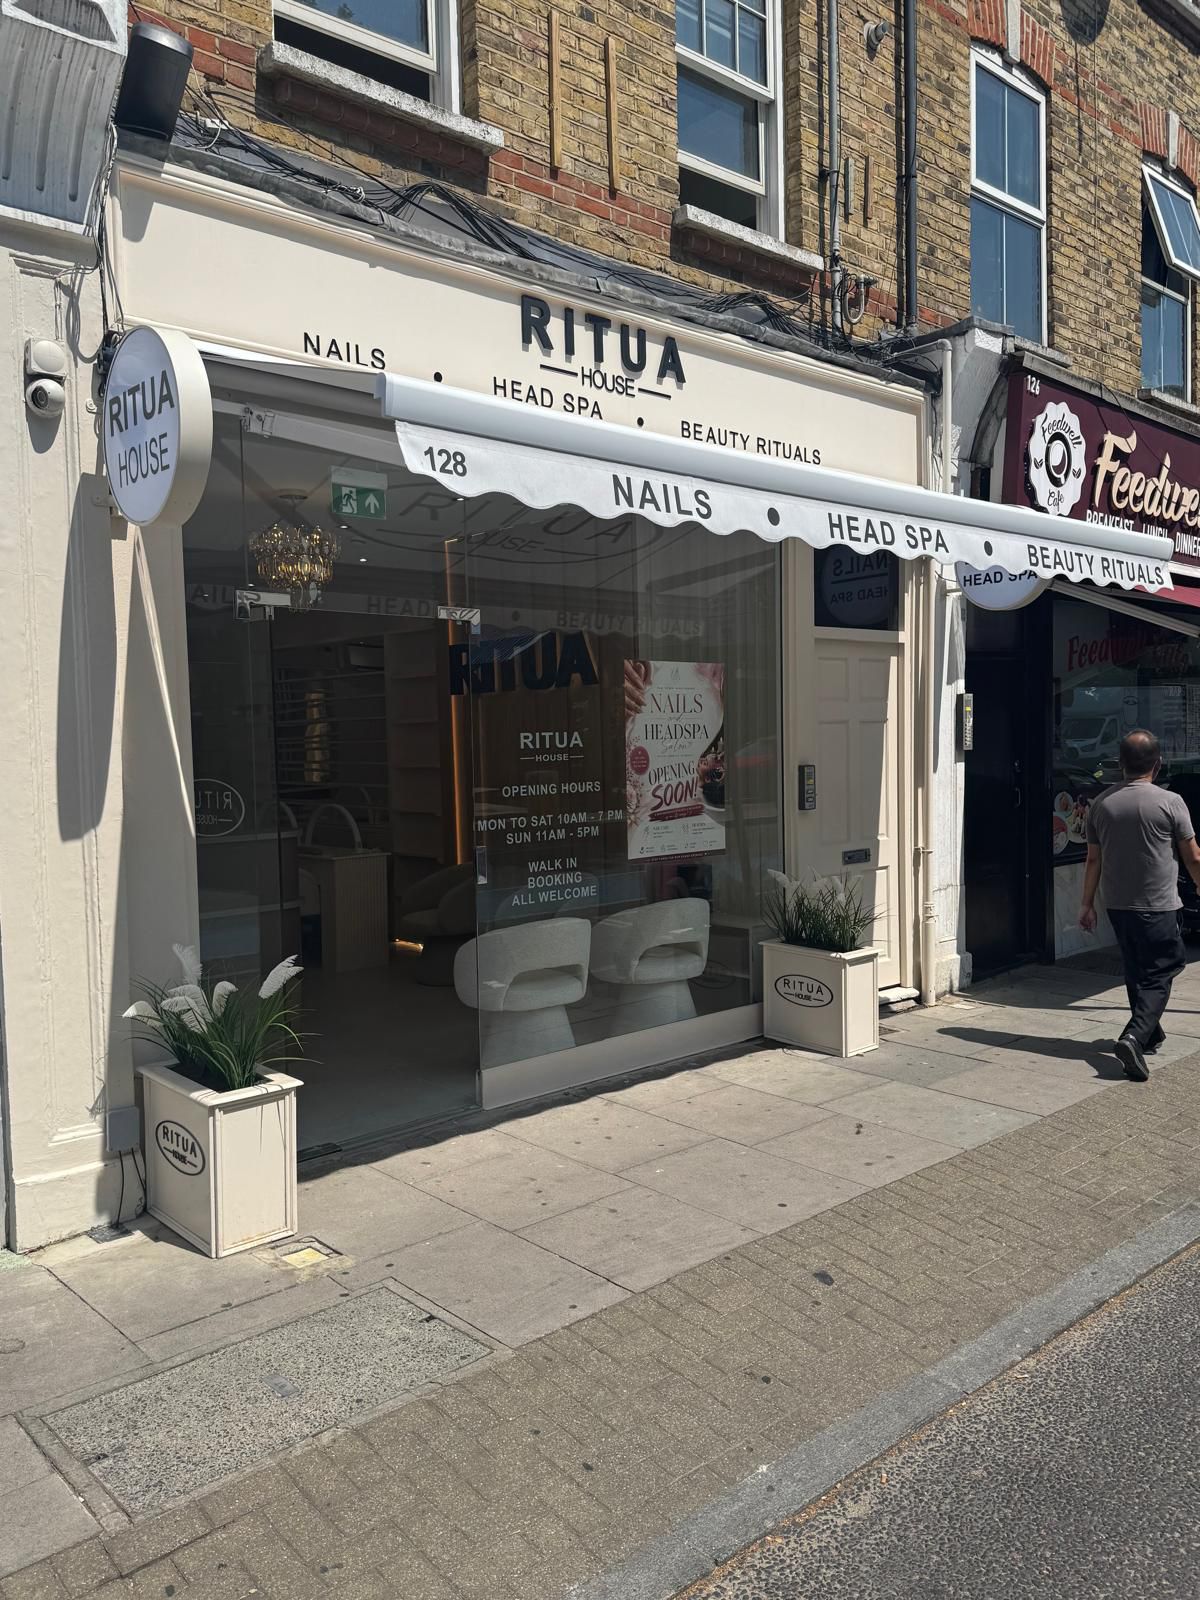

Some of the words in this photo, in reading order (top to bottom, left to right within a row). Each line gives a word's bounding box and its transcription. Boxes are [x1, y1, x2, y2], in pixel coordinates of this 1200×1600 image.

[303, 332, 386, 370] NAILS
[521, 294, 686, 384] RITUA
[580, 366, 635, 397] HOUSE
[1026, 375, 1041, 396] 126
[108, 369, 175, 437] RITUA
[493, 376, 554, 409] HEAD
[563, 393, 603, 420] SPA
[681, 420, 750, 451] BEAUTY
[756, 437, 822, 465] RITUALS
[1041, 412, 1082, 449] Feedwell
[118, 432, 171, 488] HOUSE
[424, 446, 467, 477] 128
[1094, 430, 1200, 529] Feedwe
[612, 474, 712, 520] NAILS
[1047, 487, 1065, 512] Cafe
[828, 512, 895, 547] HEAD
[905, 525, 950, 553] SPA
[1027, 543, 1095, 574] BEAUTY
[1101, 557, 1165, 586] RITUALS
[963, 571, 1003, 587] HEAD
[650, 693, 704, 713] NAILS
[519, 732, 583, 750] RITUA
[644, 723, 709, 740] HEADSPA
[535, 753, 569, 762] HOUSE
[648, 760, 696, 786] OPENING
[502, 784, 557, 797] OPENING
[561, 781, 601, 795] HOURS
[650, 777, 699, 811] SOON!
[477, 819, 506, 831] MON
[511, 817, 526, 829] TO
[531, 815, 552, 828] SAT
[557, 813, 587, 825] 10AM
[598, 811, 605, 823] 7
[607, 809, 623, 821] PM
[506, 831, 531, 844] SUN
[536, 828, 565, 841] 11AM
[577, 826, 599, 838] 5PM
[528, 859, 562, 873] WALK
[566, 857, 578, 869] IN
[527, 872, 582, 889] BOOKING
[512, 894, 535, 906] ALL
[537, 885, 597, 903] WELCOME
[783, 978, 824, 996] RITUA
[795, 992, 812, 1001] HOUSE
[162, 1125, 197, 1158] RITUA
